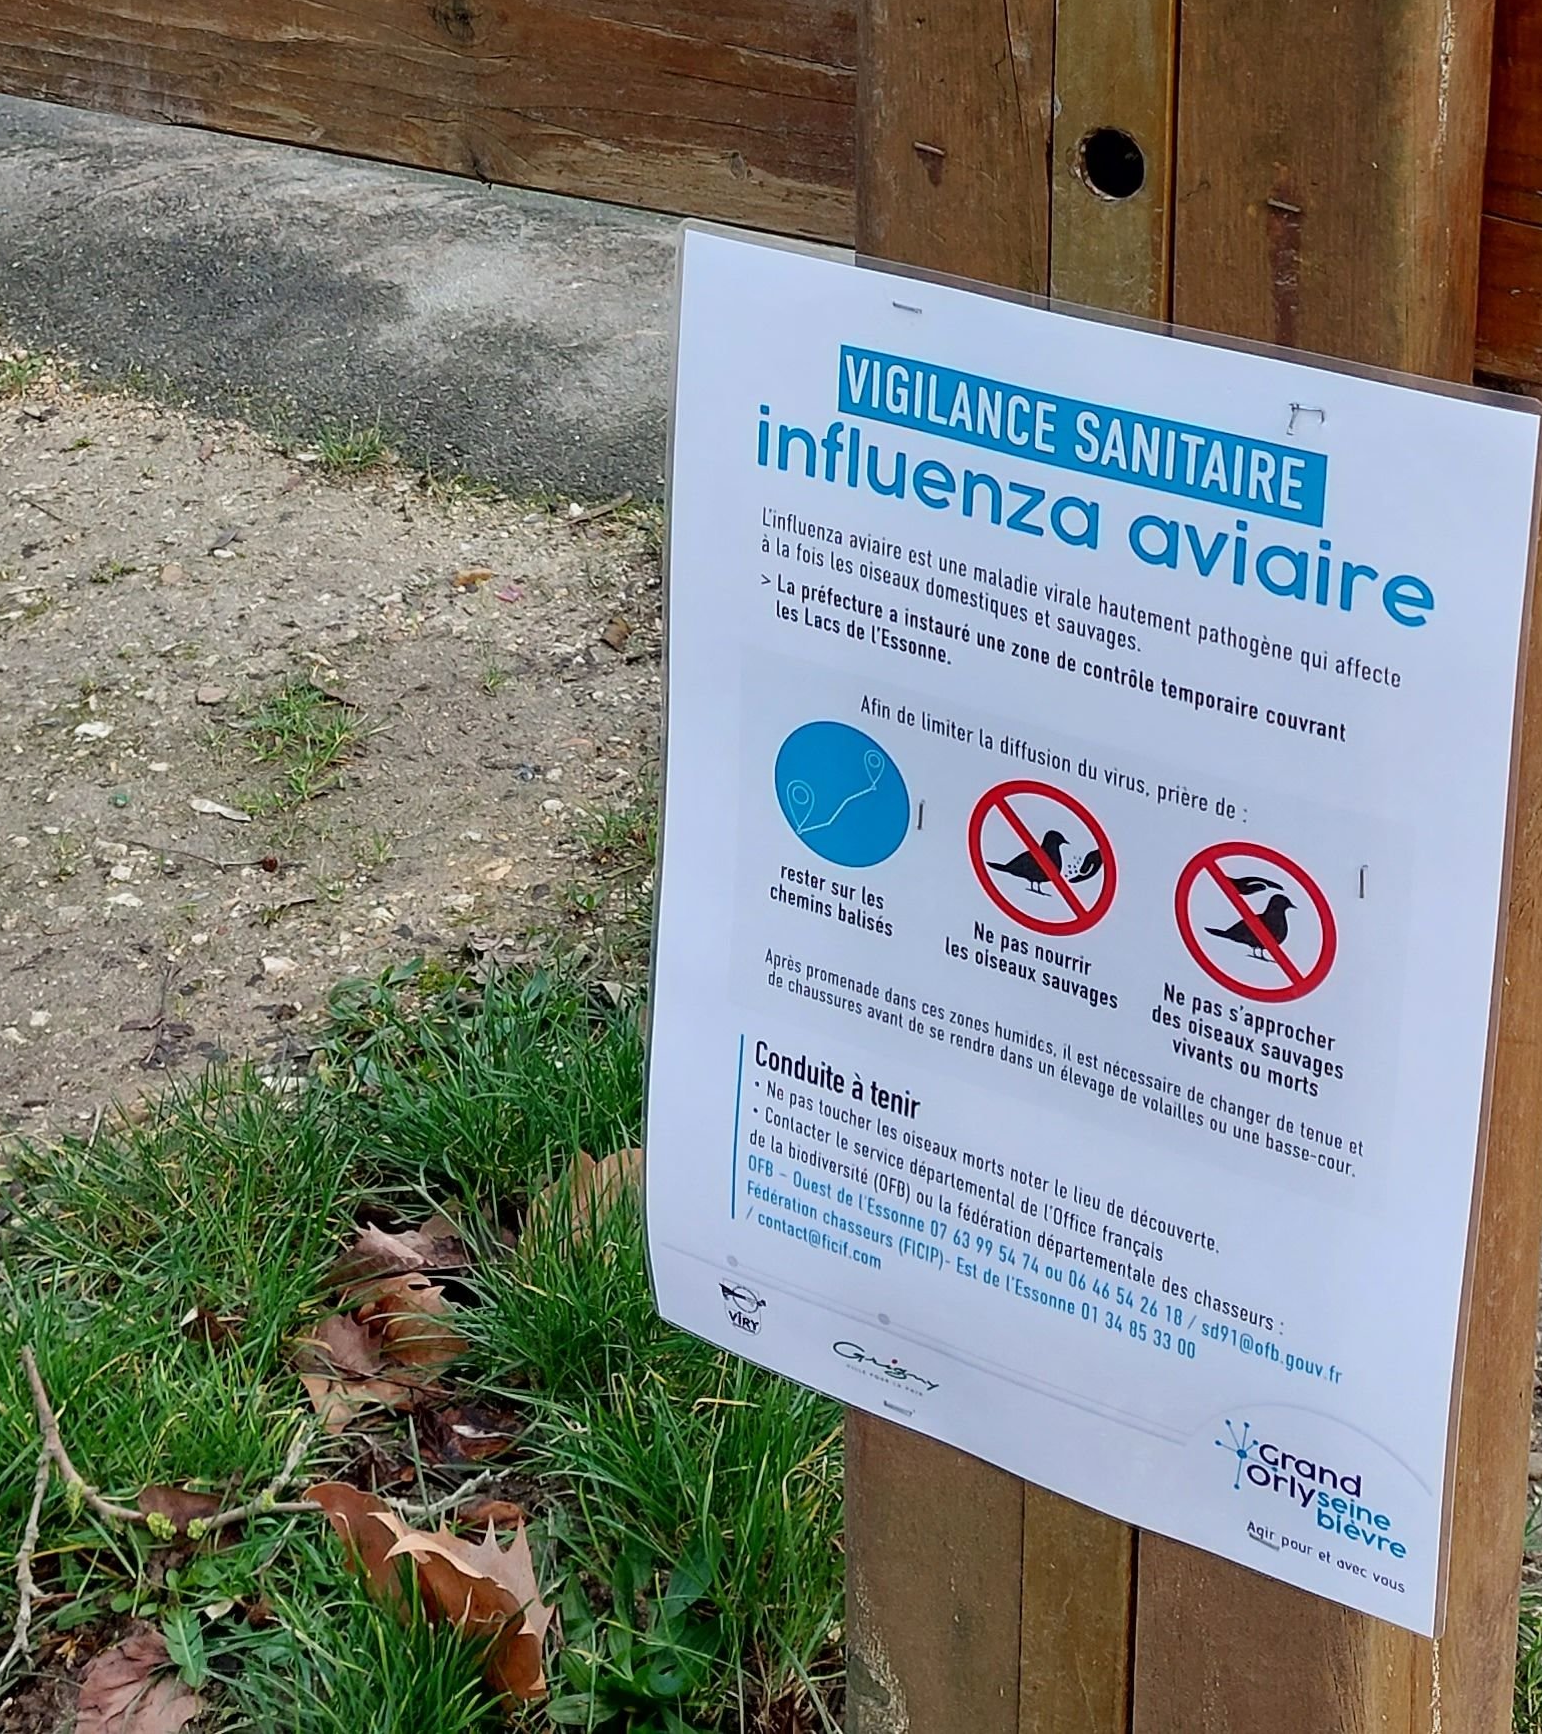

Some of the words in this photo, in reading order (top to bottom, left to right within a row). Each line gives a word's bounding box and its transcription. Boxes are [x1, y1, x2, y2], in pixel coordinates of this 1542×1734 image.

[843, 353, 1056, 454] VIGILANCE
[1073, 410, 1307, 511] SANITAIRE
[756, 402, 1100, 551] influenza
[1127, 513, 1436, 629] aviaire
[761, 505, 843, 545] L'influenza
[848, 532, 902, 560] aviaire
[907, 547, 933, 569] est
[938, 555, 967, 578] une
[972, 565, 1038, 597] maladie
[1043, 581, 1092, 611] virale
[1097, 593, 1191, 637] hautement
[1196, 623, 1293, 662] pathogène
[1299, 649, 1328, 673] qui
[1334, 655, 1401, 688] affecte
[775, 535, 790, 559] la
[795, 541, 824, 567] fois
[829, 549, 854, 575] les
[858, 559, 920, 593] oiseaux
[924, 576, 1028, 622] domestiques
[1033, 608, 1051, 629] et
[1055, 616, 1141, 653] sauvages.
[775, 598, 799, 623] les
[803, 605, 841, 634] Lacs
[845, 618, 865, 641] de
[870, 623, 952, 666] l'Essonne.
[776, 572, 795, 596] La
[800, 583, 883, 619] préfecture
[903, 606, 971, 643] instauré
[975, 631, 1006, 653] une
[1010, 641, 1050, 666] zone
[1056, 649, 1076, 673] de
[1082, 660, 1154, 693] contrôle
[1160, 676, 1259, 720] temporaire
[1265, 708, 1346, 743] couvrant
[859, 693, 891, 721] Afin
[896, 704, 915, 727] de
[920, 709, 974, 744] limiter
[978, 726, 993, 751] la
[999, 734, 1071, 774] diffusion
[1076, 757, 1097, 781] du
[1102, 766, 1150, 798] virus,
[1156, 783, 1208, 812] prière
[1214, 795, 1236, 819] de
[769, 882, 832, 918] chemins
[836, 900, 893, 937] balisés
[779, 864, 827, 891] rester
[829, 880, 857, 901] sur
[860, 884, 884, 910] les
[944, 934, 969, 961] les
[974, 947, 1037, 983] oiseaux
[1040, 971, 1118, 1009] sauvages
[972, 919, 995, 944] Ne
[999, 933, 1029, 955] pas
[1034, 944, 1092, 976] nourrir
[763, 946, 802, 974] Après
[805, 964, 880, 999] promenade
[883, 986, 917, 1011] dans
[920, 1001, 945, 1020] ces
[948, 1009, 990, 1034] zones
[1076, 1051, 1099, 1071] est
[1102, 1059, 1181, 1098] nécessaire
[1209, 1093, 1271, 1127] changer
[1299, 1120, 1343, 1150] tenue
[1348, 1139, 1364, 1158] et
[1150, 1003, 1182, 1030] des
[1187, 1016, 1255, 1053] oiseaux
[1259, 1041, 1344, 1080] sauvages
[1162, 980, 1185, 1006] Ne
[1190, 995, 1223, 1018] pas
[1227, 1003, 1336, 1052] s'approcher
[754, 1039, 845, 1094] Conduite
[850, 1071, 864, 1102] à
[869, 1079, 921, 1120] tenir
[787, 977, 863, 1015] chaussures
[866, 1005, 904, 1029] avant
[949, 1031, 995, 1057] rendre
[999, 1044, 1033, 1070] dans
[1059, 1063, 1115, 1099] élevage
[1119, 1084, 1137, 1105] de
[1141, 1094, 1204, 1127] volailles
[1232, 1124, 1260, 1145] une
[1264, 1130, 1356, 1178] basse-cour.
[1171, 1036, 1234, 1071] vivants
[1239, 1059, 1261, 1079] ou
[1266, 1068, 1319, 1097] morts
[764, 1105, 832, 1144] Contacter
[835, 1129, 849, 1151] le
[852, 1141, 904, 1170] service
[908, 1157, 1015, 1210] départemental
[1019, 1195, 1038, 1218] de
[1042, 1202, 1097, 1238] l'Office
[1101, 1223, 1163, 1262] français
[765, 1078, 784, 1101] Ne
[788, 1091, 814, 1112] pas
[817, 1097, 872, 1131] toucher
[875, 1116, 898, 1141] les
[901, 1128, 958, 1162] oiseaux
[961, 1150, 1005, 1178] morts
[1009, 1166, 1050, 1193] noter
[1053, 1177, 1068, 1200] le
[1072, 1184, 1101, 1211] lieu
[1105, 1197, 1124, 1219] de
[1129, 1205, 1219, 1254] découverte.
[748, 1128, 766, 1149] de
[769, 1134, 783, 1155] la
[787, 1140, 868, 1185] biodiversité
[872, 1171, 911, 1204] (OFB)
[915, 1190, 934, 1208] ou
[937, 1193, 952, 1215] la
[957, 1200, 1031, 1244] fédération
[1036, 1229, 1156, 1288] départementale
[1160, 1274, 1188, 1300] des
[1193, 1288, 1274, 1331] chasseurs
[756, 1212, 882, 1270] contact@ficif.com
[746, 1178, 818, 1220] Fédération
[821, 1209, 893, 1248] chasseurs
[955, 1254, 977, 1280] Est
[982, 1266, 1000, 1288] de
[1004, 1273, 1076, 1315] l'Essonne
[1080, 1301, 1098, 1324] 01
[1103, 1309, 1123, 1333] 34
[1127, 1318, 1147, 1342] 85
[1151, 1327, 1172, 1351] 33
[1176, 1336, 1196, 1360] 00
[747, 1152, 774, 1178] OFB
[792, 1169, 832, 1200] Ouest
[836, 1186, 853, 1207] de
[857, 1192, 925, 1233] l'Essonne
[929, 1218, 948, 1240] 07
[951, 1227, 970, 1249] 63
[974, 1235, 993, 1257] 99
[997, 1243, 1016, 1266] 54
[1021, 1251, 1039, 1275] 74
[1044, 1264, 1063, 1283] ou
[1067, 1268, 1086, 1291] 06
[1091, 1277, 1110, 1300] 46
[1115, 1284, 1134, 1309] 54
[1138, 1294, 1158, 1318] 26
[1164, 1304, 1183, 1327] 18
[1201, 1319, 1343, 1385] sd91@ofb.gouv.fr
[728, 1310, 760, 1331] VIRY
[833, 1341, 940, 1391] Grigny
[1246, 1464, 1316, 1508] Orly
[1317, 1490, 1391, 1530] seine
[1258, 1443, 1363, 1498] Grand
[1281, 1535, 1312, 1556] pour
[1317, 1549, 1331, 1564] et
[1335, 1558, 1367, 1579] avec
[1371, 1571, 1405, 1594] vous
[1316, 1509, 1408, 1559] bièvre
